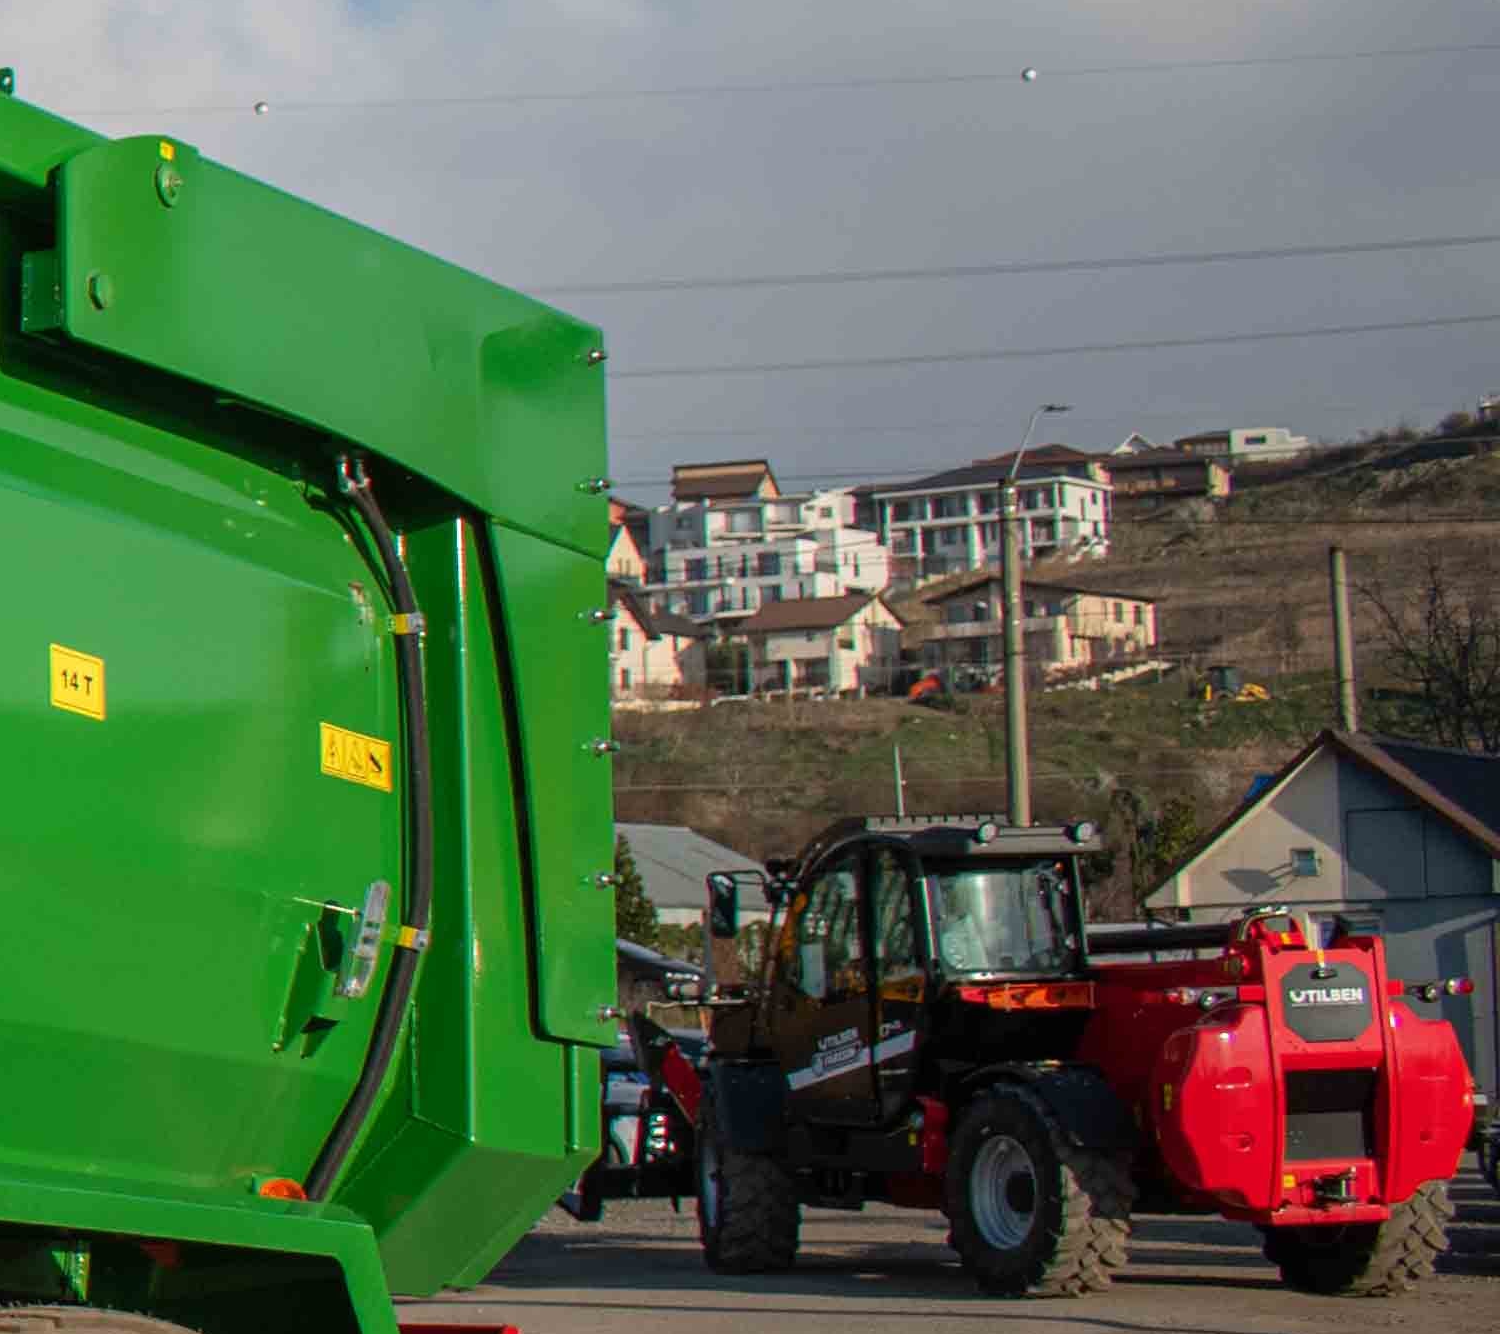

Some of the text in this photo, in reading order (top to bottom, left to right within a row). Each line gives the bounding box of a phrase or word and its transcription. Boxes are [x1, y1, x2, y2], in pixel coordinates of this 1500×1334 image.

[62, 670, 93, 696] 14 T
[1288, 987, 1364, 1004] UTILBEN
